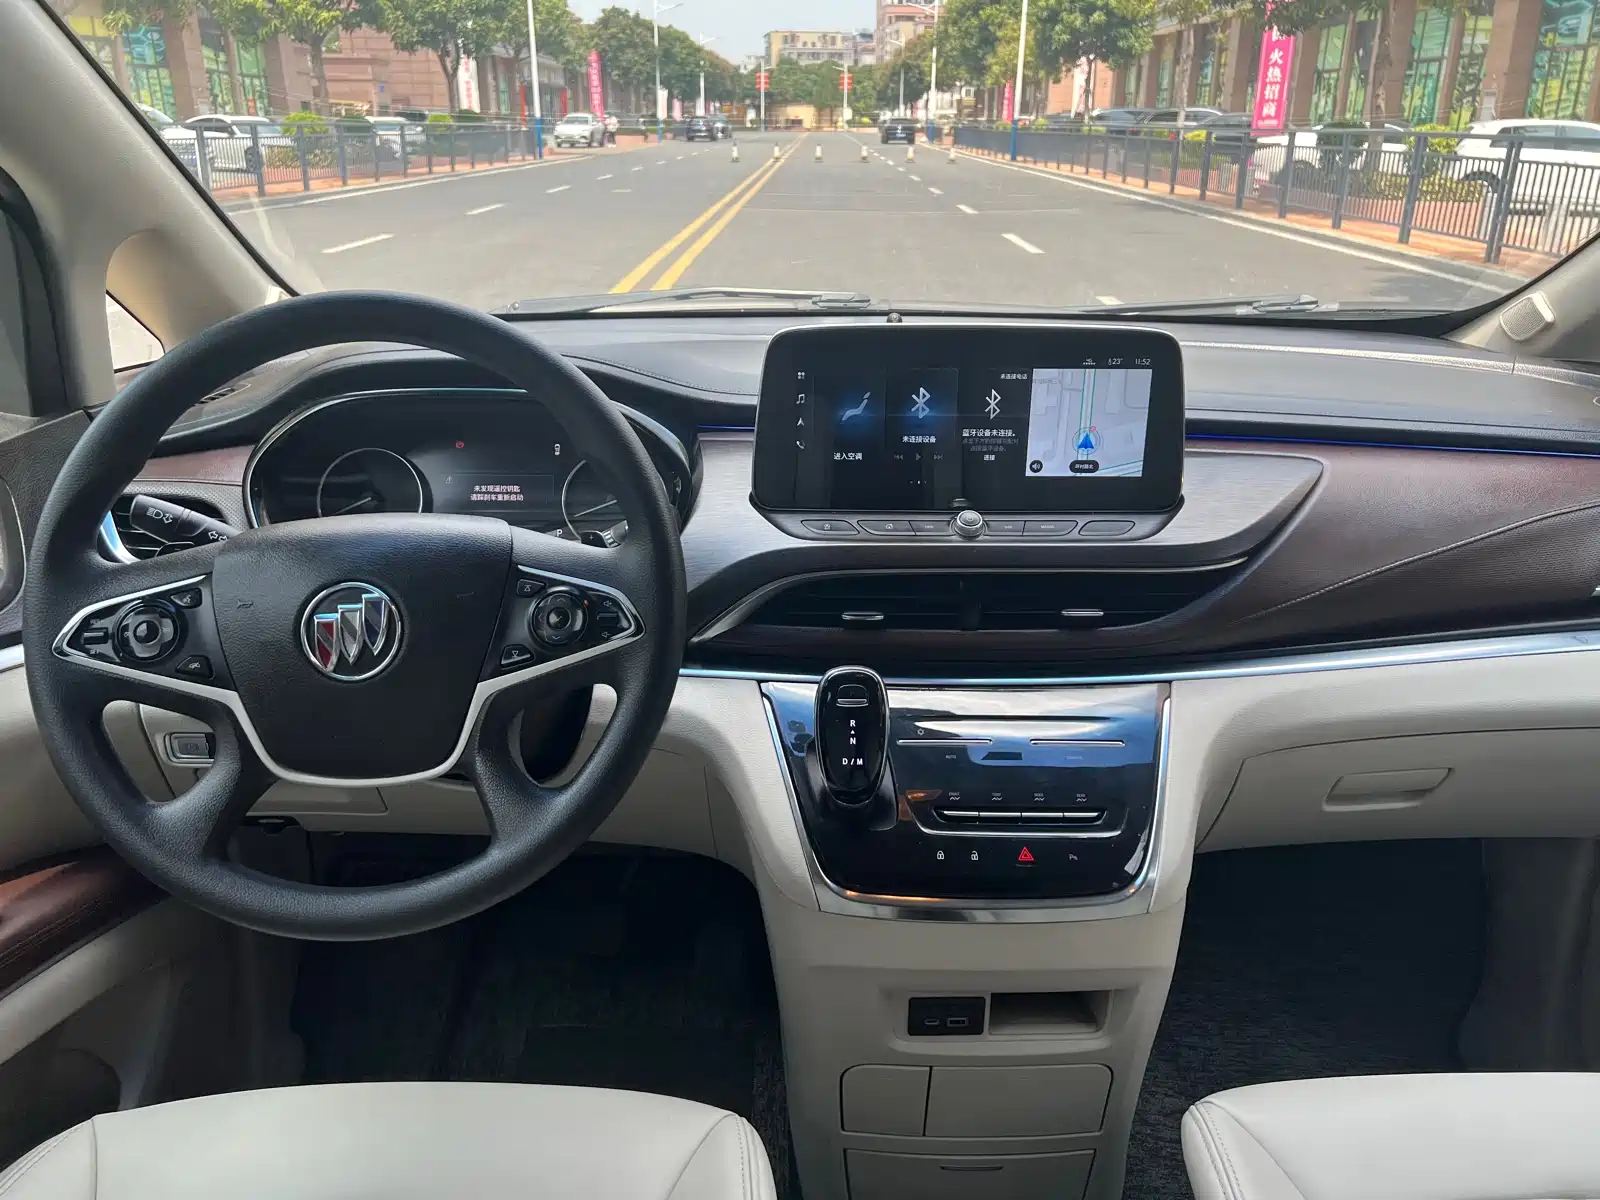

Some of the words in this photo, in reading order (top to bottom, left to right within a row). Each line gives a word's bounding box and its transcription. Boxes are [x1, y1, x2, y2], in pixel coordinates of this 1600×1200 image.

[1262, 48, 1284, 117] 火热招商
[902, 435, 937, 443] 未连接设备
[833, 452, 862, 460] 进入空调
[983, 454, 996, 462] 连接
[473, 485, 521, 493] 未发现遥控钥匙
[470, 493, 524, 502] 请踩刹车重新启动
[556, 529, 563, 538] P
[850, 719, 857, 728] R
[850, 737, 857, 745] N
